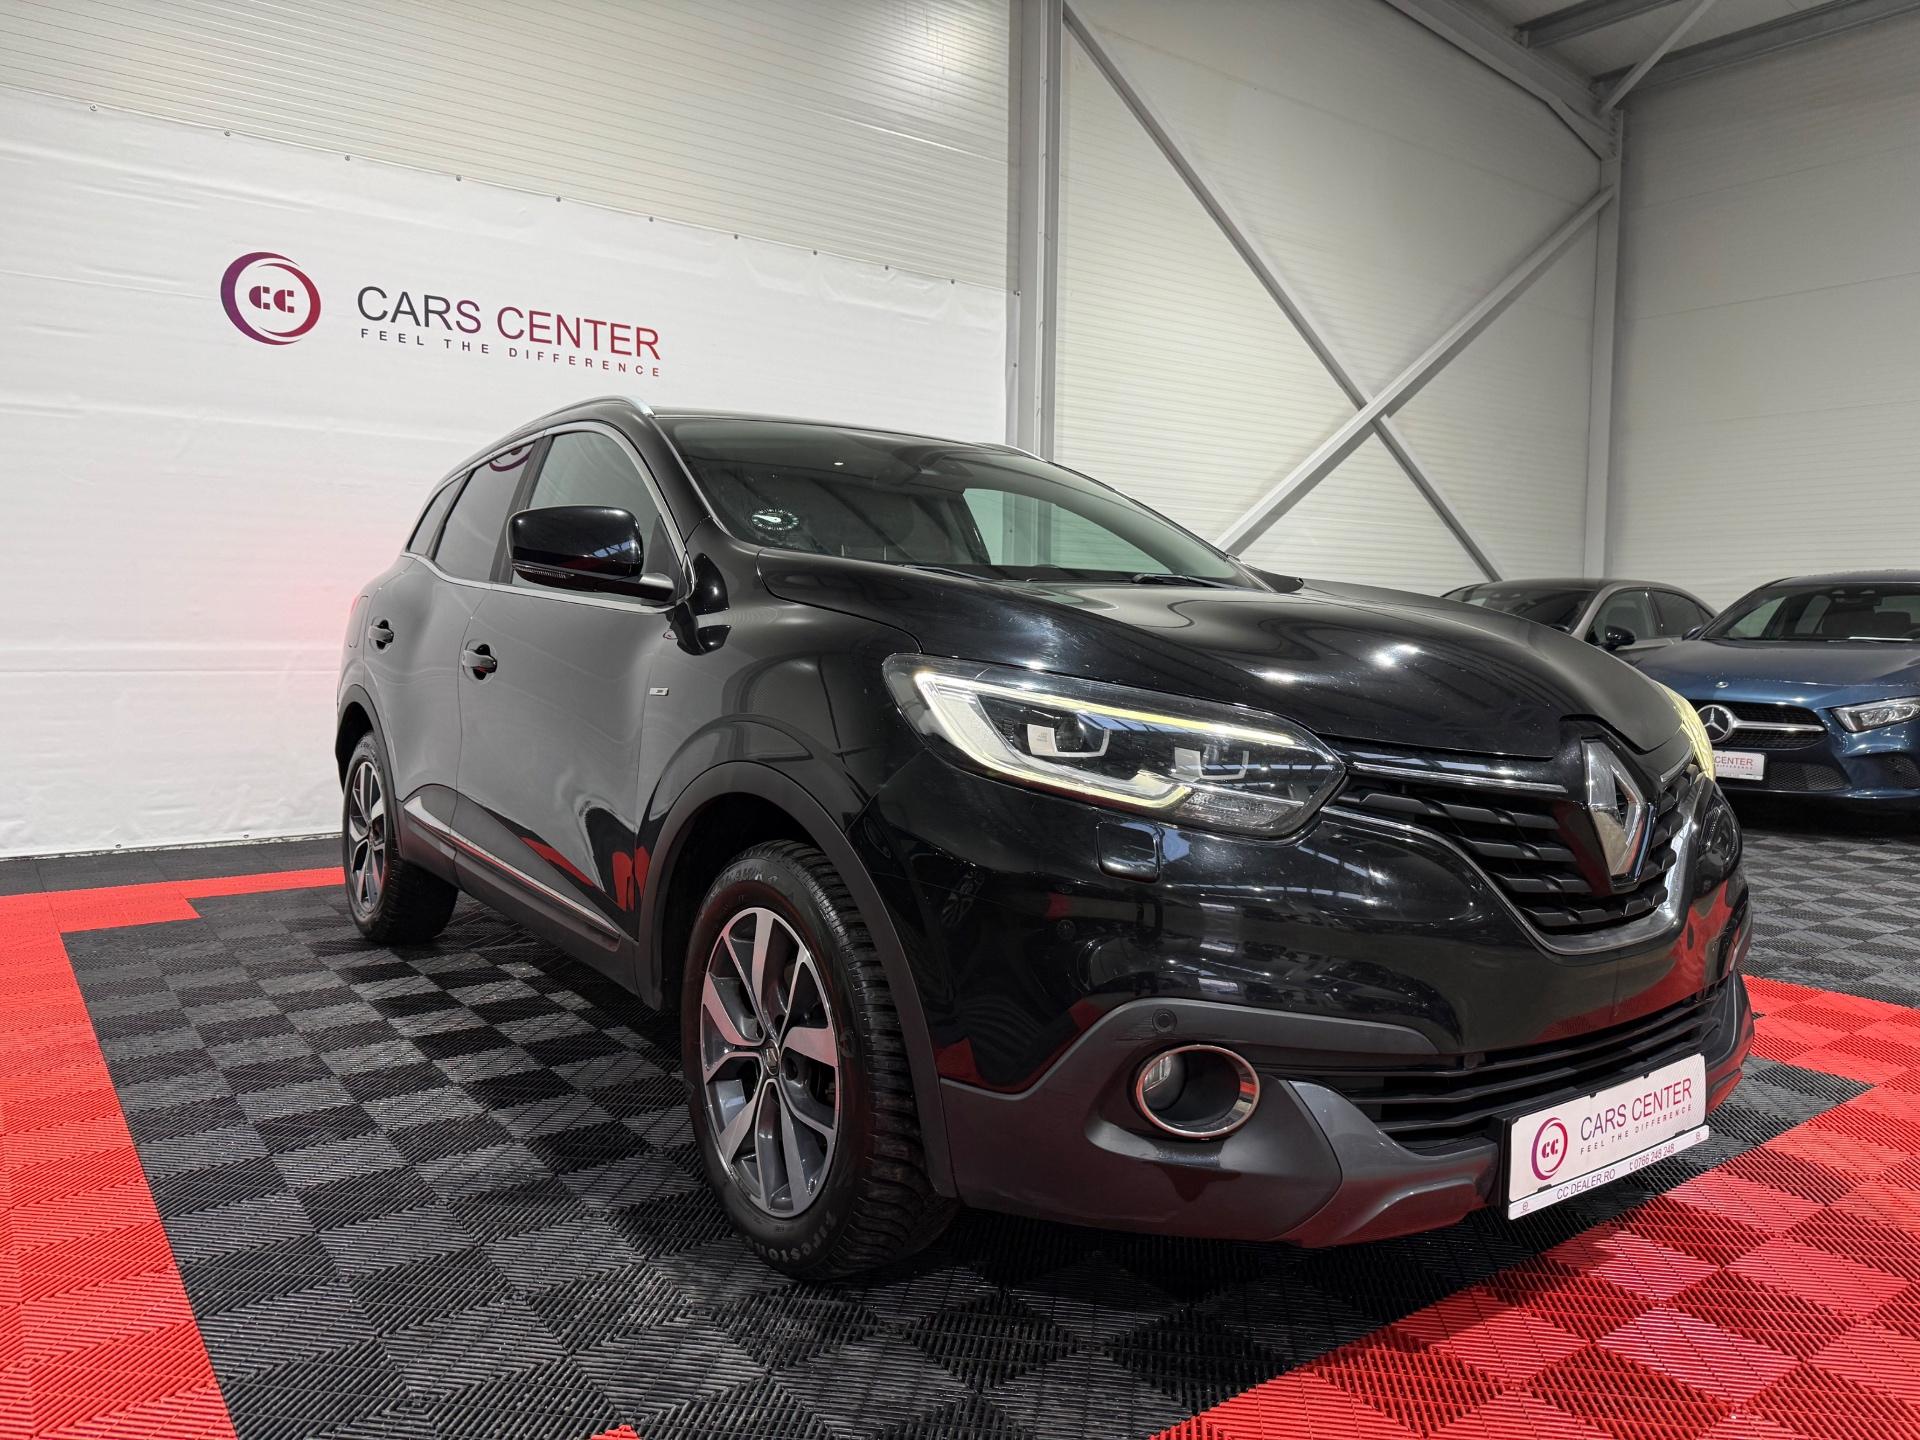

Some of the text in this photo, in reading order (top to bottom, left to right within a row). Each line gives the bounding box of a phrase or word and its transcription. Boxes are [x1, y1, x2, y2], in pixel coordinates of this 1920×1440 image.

[248, 285, 295, 313] CC
[357, 286, 661, 360] CARS CENTER
[361, 328, 660, 377] FEEL THE DIFFERENCE
[1714, 755, 1753, 767] CENTER
[1580, 1078, 1692, 1141] CARS CENTER
[1580, 1104, 1692, 1155] FEEL THE DIFFERENCE
[1634, 1154, 1650, 1169] 0766
[1556, 1168, 1616, 1199] CC DEALER.RO
